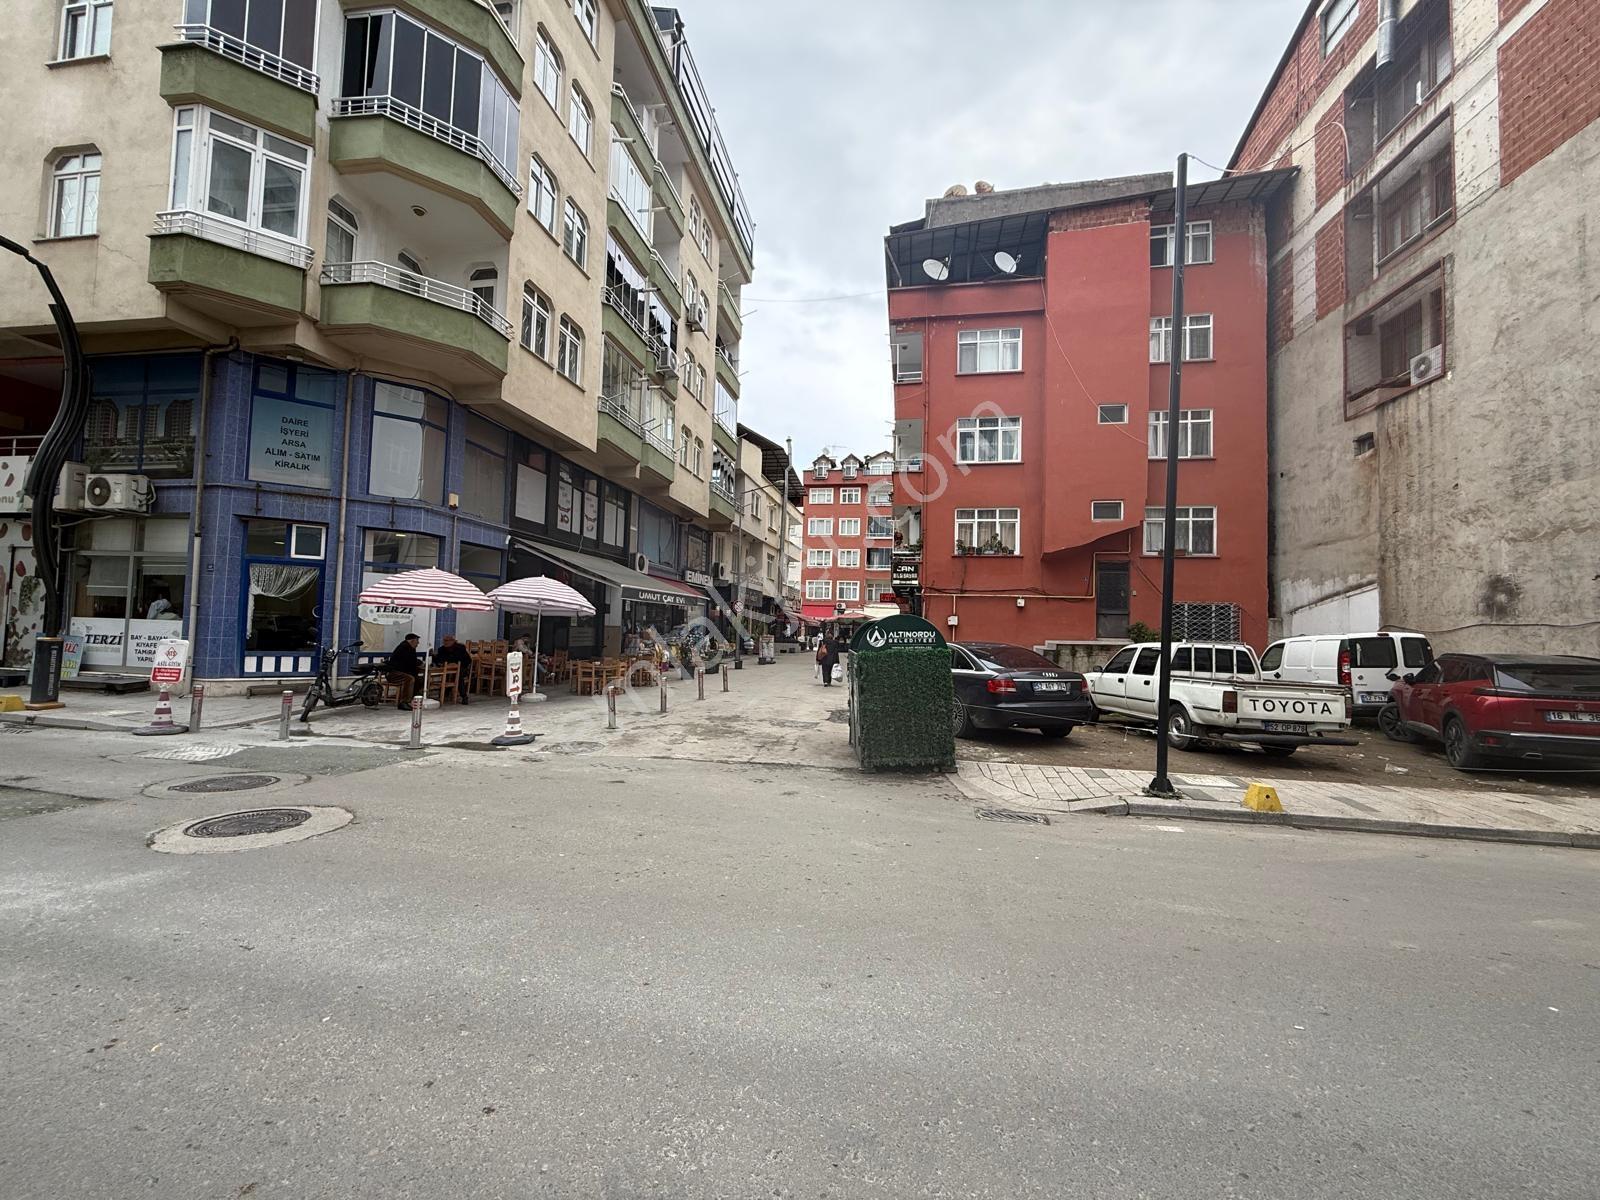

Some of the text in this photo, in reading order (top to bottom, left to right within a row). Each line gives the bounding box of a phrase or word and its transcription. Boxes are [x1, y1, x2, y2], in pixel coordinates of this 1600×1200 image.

[281, 438, 307, 448] ARSA
[264, 447, 287, 457] ALIM
[294, 451, 321, 462] SATIM
[274, 459, 311, 471] KİRALIK
[638, 591, 661, 601] UMUT
[662, 595, 675, 604] ÇAY
[85, 632, 124, 646] TERZİ
[1249, 699, 1332, 715] TOYOTA
[1552, 712, 1563, 720] 16
